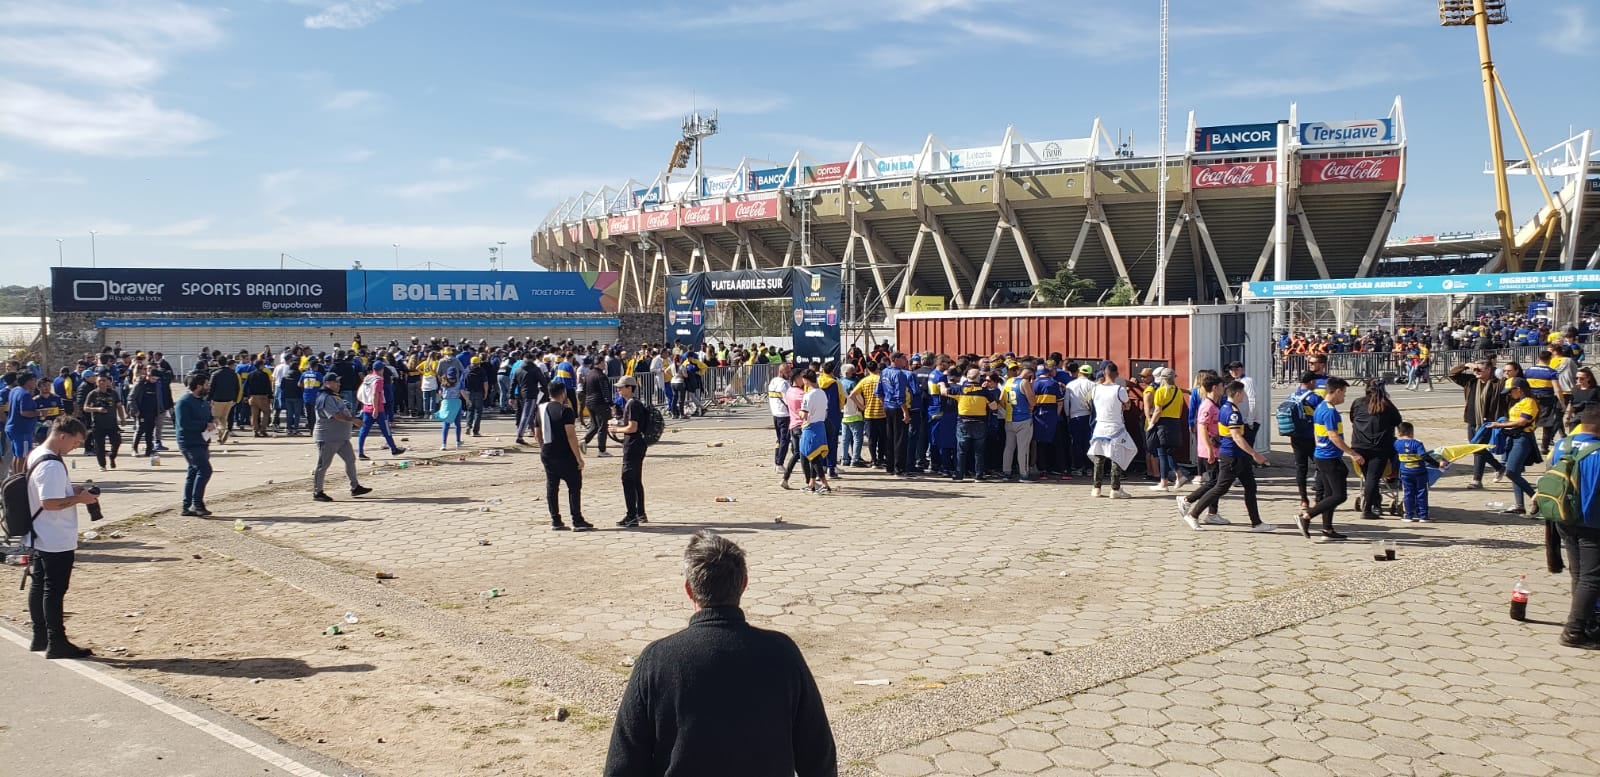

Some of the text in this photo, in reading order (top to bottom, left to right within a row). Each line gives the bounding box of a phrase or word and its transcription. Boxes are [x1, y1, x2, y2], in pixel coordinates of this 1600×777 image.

[1212, 130, 1272, 145] BANCOR
[1312, 126, 1378, 141] Tersuave
[1195, 165, 1255, 187] Coca-Cola
[1320, 159, 1386, 181] Coca-Cola
[109, 280, 165, 294] braver
[181, 282, 323, 297] SPORTS BRANDING
[392, 281, 520, 301] BOLETERÍA
[531, 288, 577, 296] TICKET OFFICE
[711, 278, 783, 291] PLATEA ARDILES SUR
[272, 302, 322, 310] grupobraver
